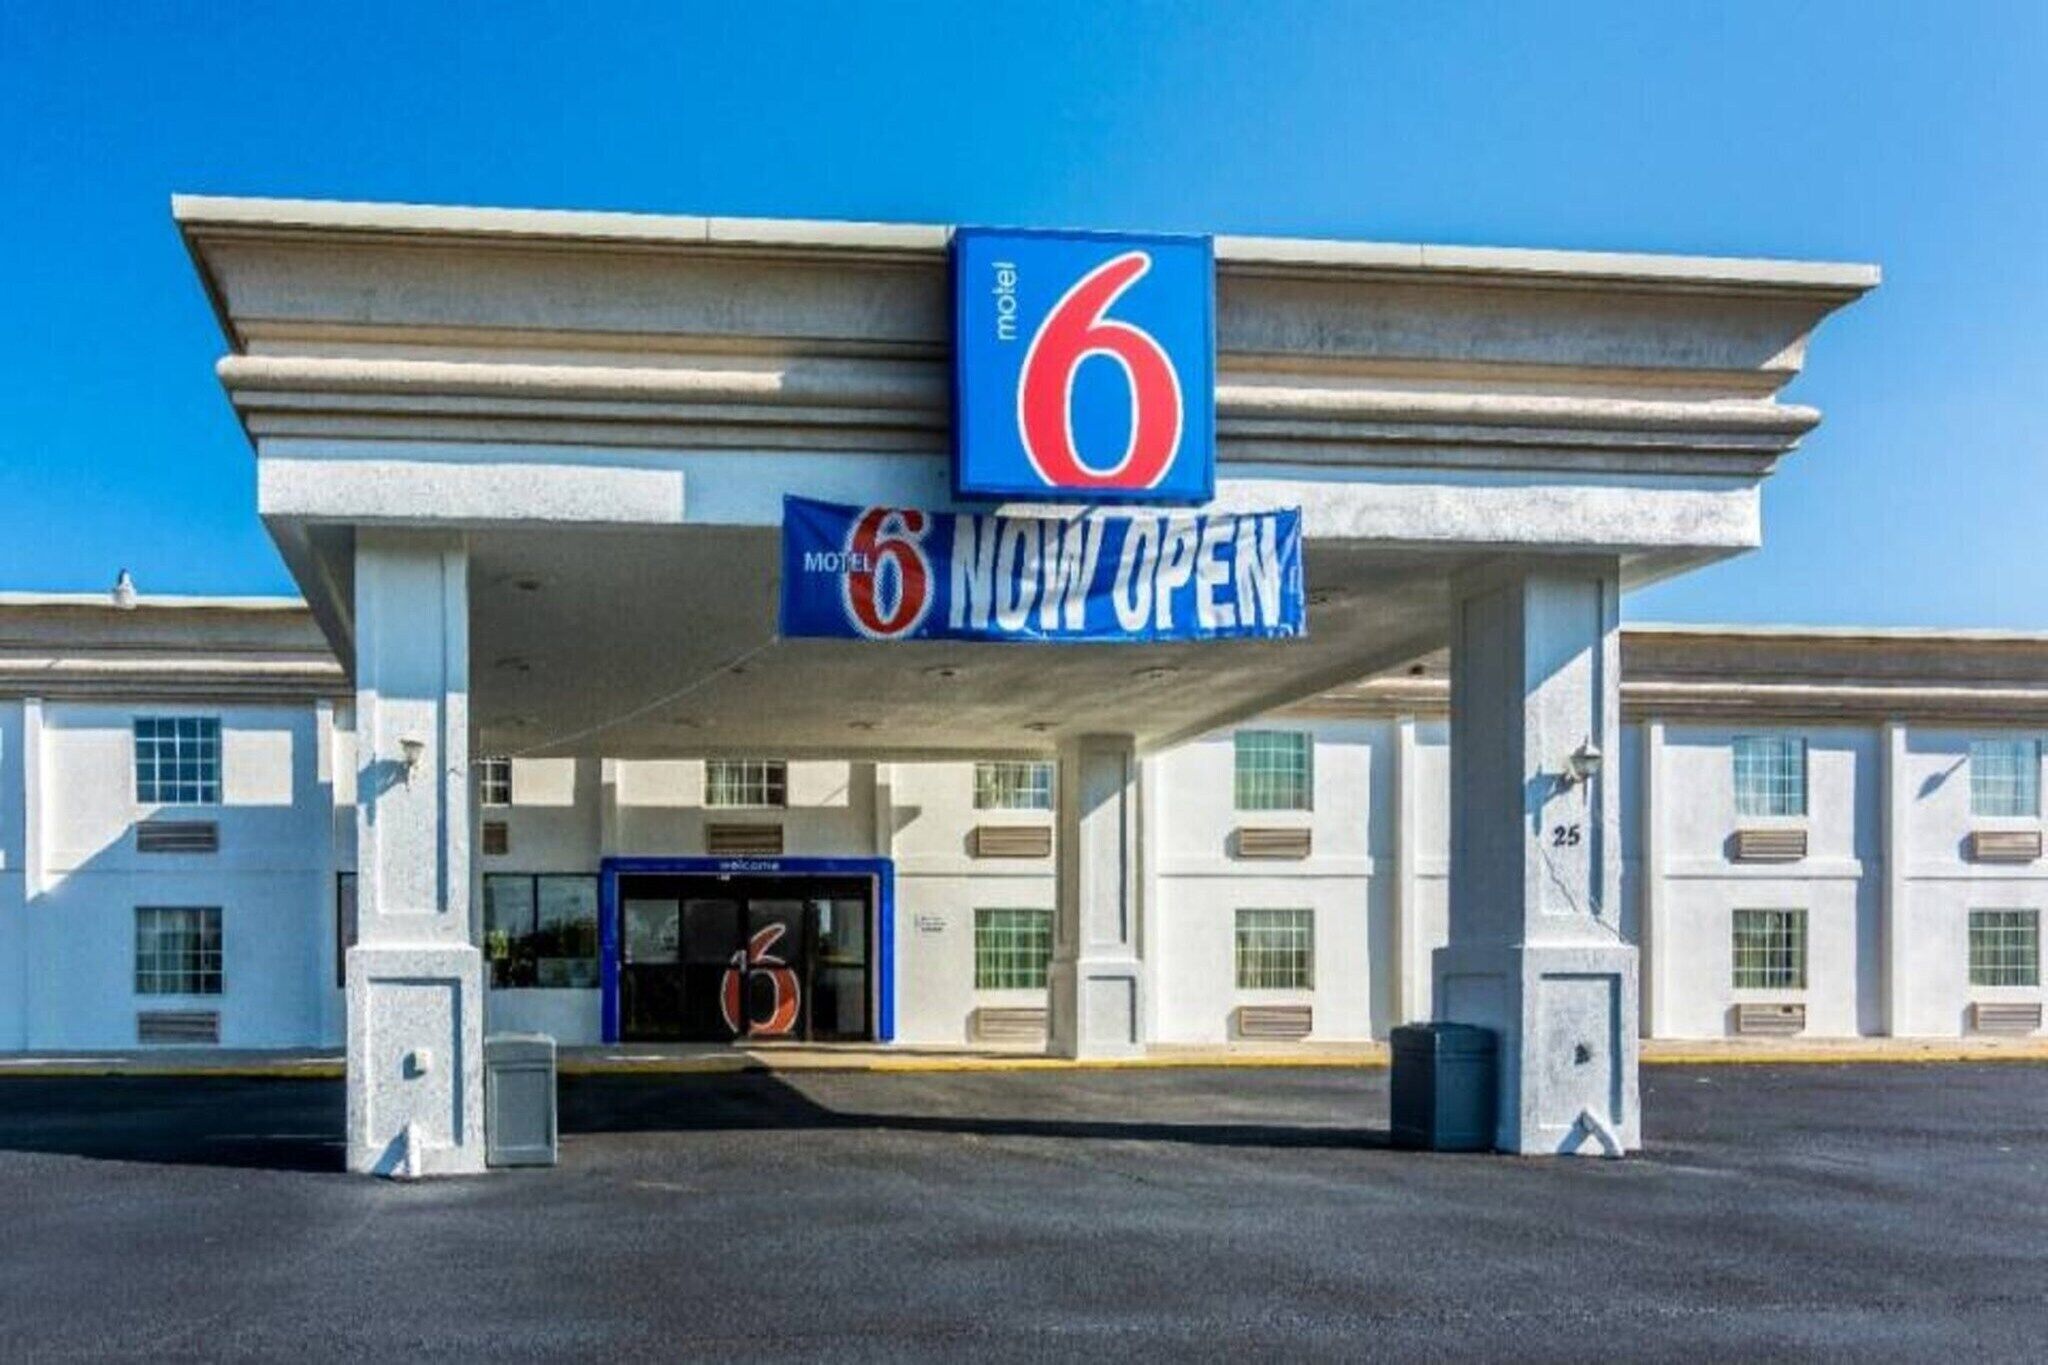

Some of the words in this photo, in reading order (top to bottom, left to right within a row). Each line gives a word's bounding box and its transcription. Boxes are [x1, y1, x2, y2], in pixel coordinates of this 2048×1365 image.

[992, 261, 1017, 340] motel
[1017, 251, 1184, 488] 6
[804, 551, 872, 573] MOTEL
[842, 505, 935, 639] 6
[950, 514, 1104, 631] NOW
[1113, 515, 1280, 631] OPEN
[1553, 824, 1580, 847] 25
[721, 923, 800, 1035] 6
